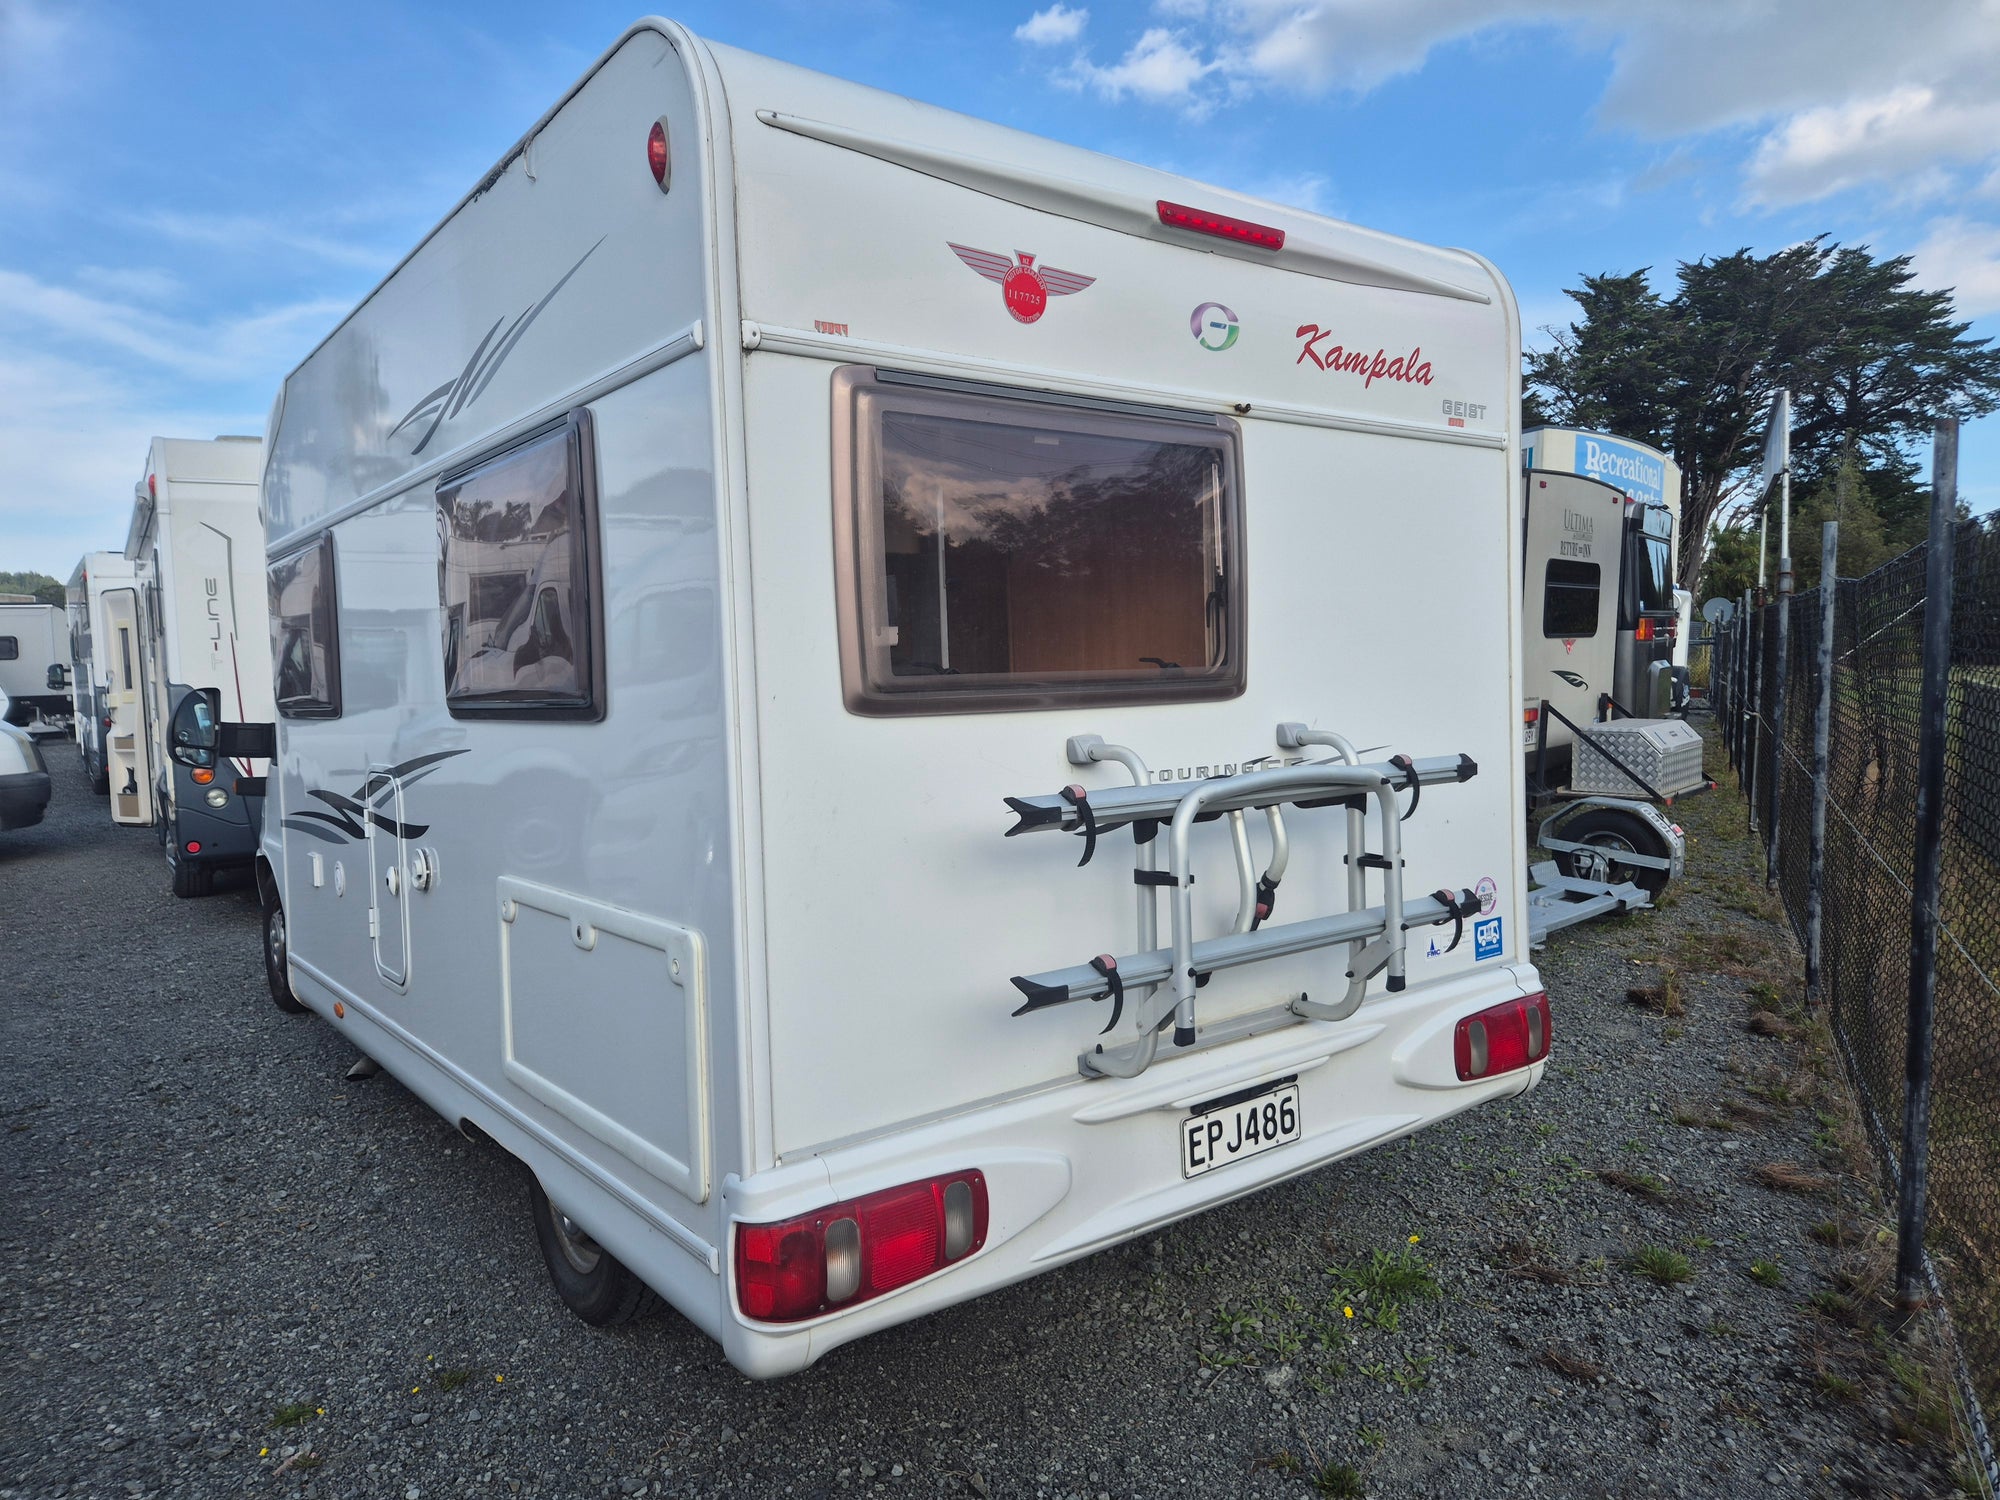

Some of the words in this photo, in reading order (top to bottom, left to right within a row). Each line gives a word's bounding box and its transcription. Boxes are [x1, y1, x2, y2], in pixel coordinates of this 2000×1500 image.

[1007, 267, 1023, 282] MOTOR
[1024, 267, 1046, 290] CARAVAN
[1008, 288, 1041, 305] 117725
[1009, 305, 1041, 323] ASSOCIATION
[1296, 324, 1434, 390] Kampala
[1442, 399, 1487, 420] GEIST
[1584, 441, 1661, 490] Recreational
[1563, 508, 1594, 533] ULTIMA
[204, 577, 223, 672] T-LINE
[1427, 949, 1441, 957] FMC
[1189, 1096, 1295, 1168] EPJ486
